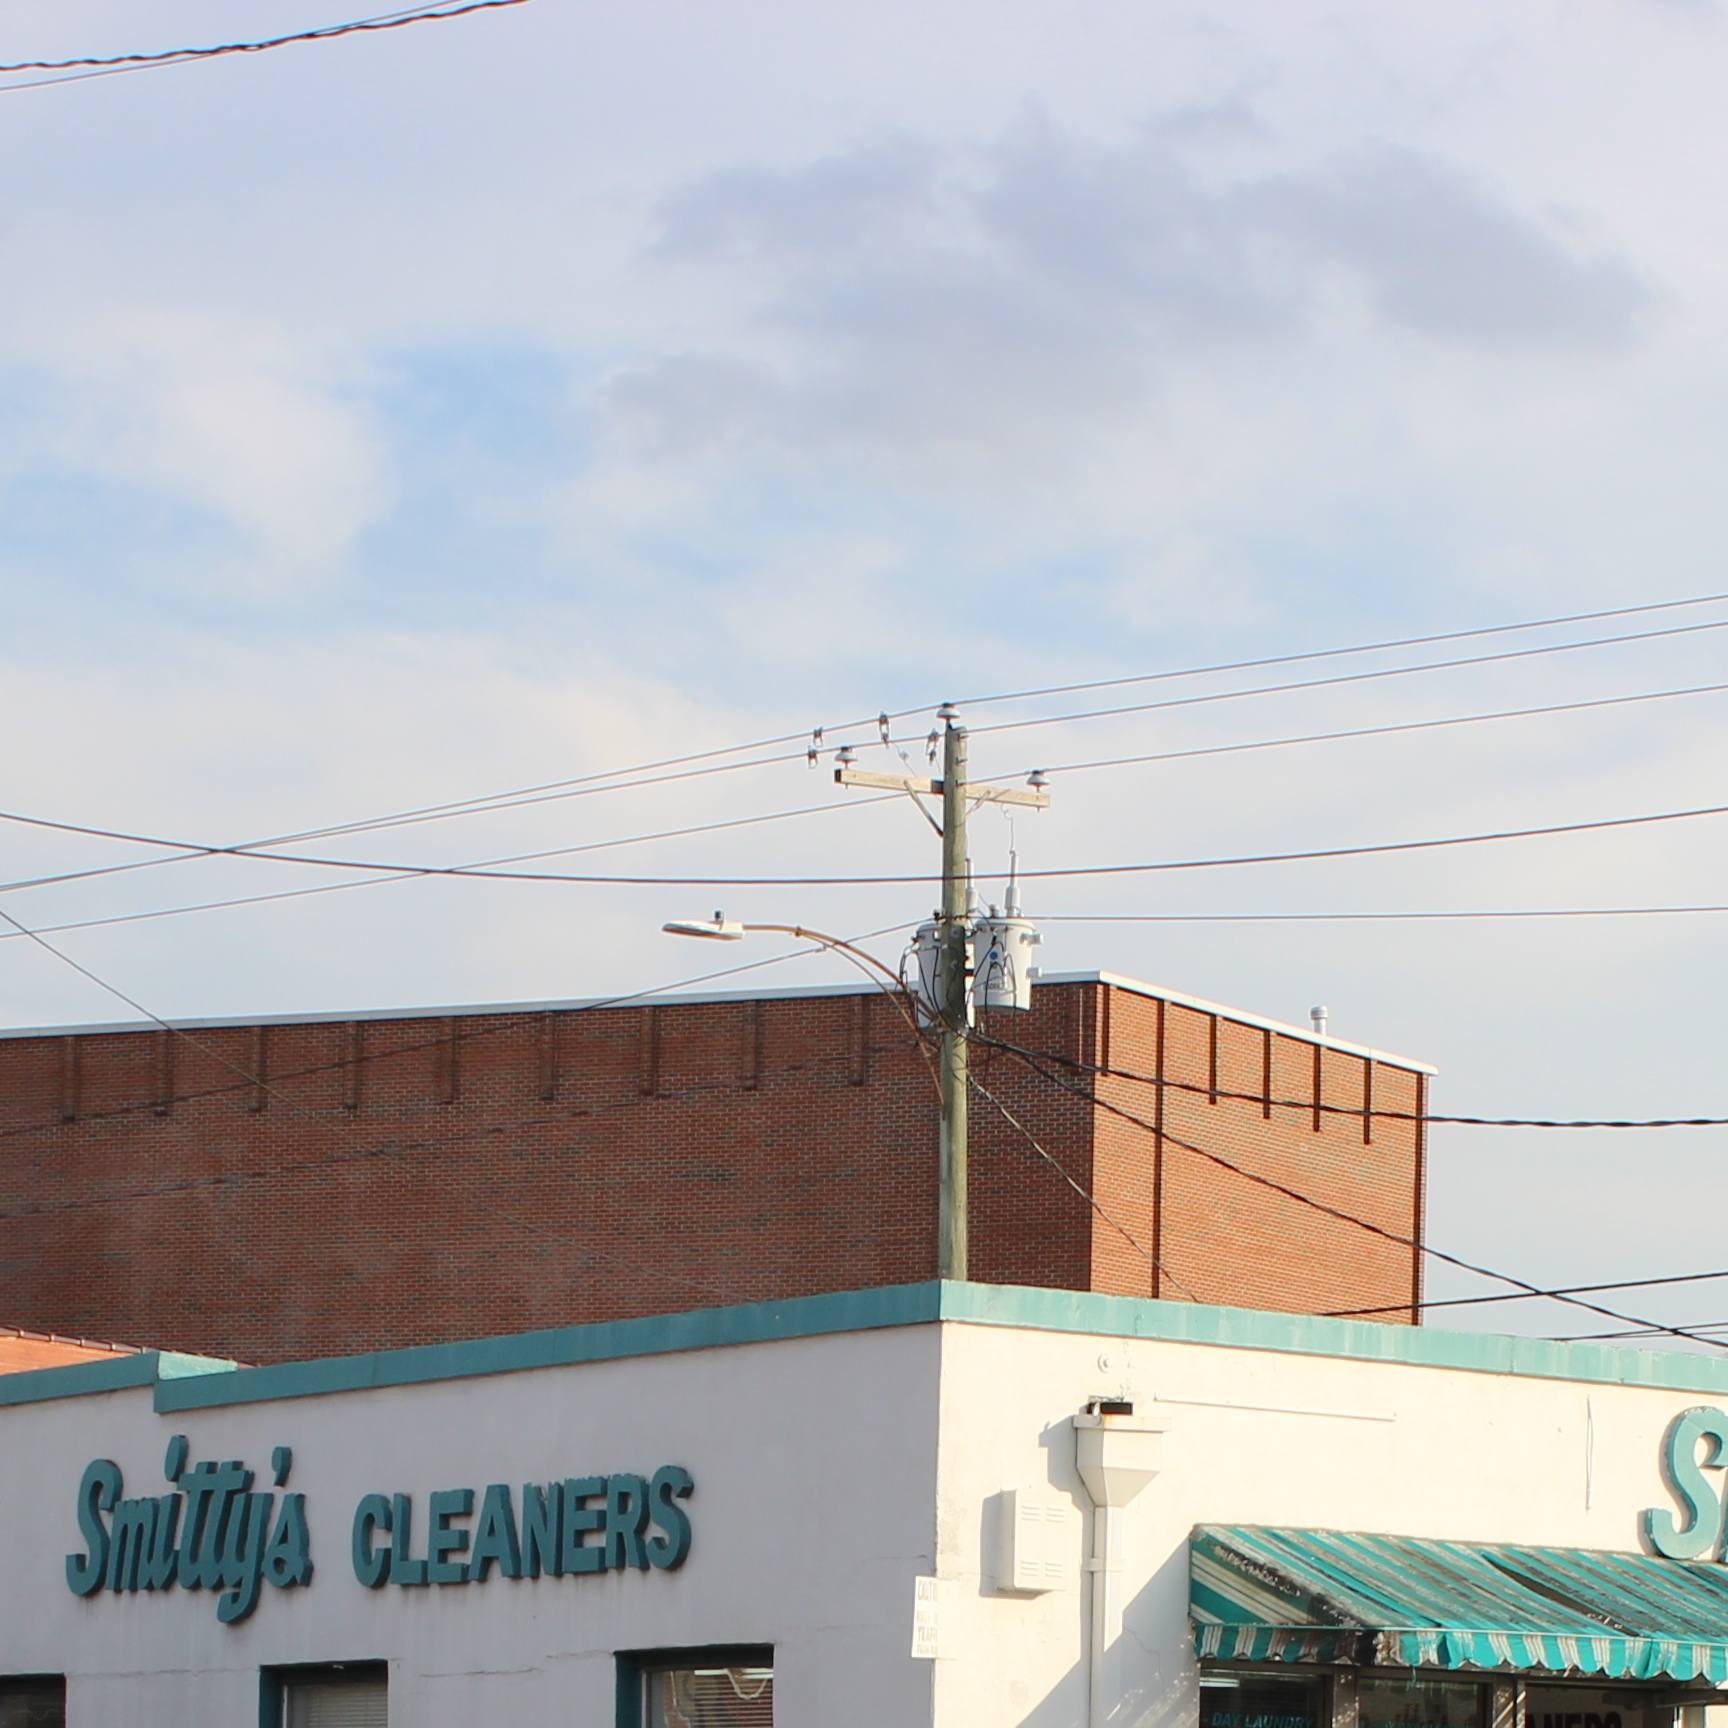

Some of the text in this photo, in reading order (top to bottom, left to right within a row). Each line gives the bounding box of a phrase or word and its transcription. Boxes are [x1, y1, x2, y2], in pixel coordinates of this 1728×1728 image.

[65, 1434, 694, 1625] Smitty's CLEANERS
[1212, 1712, 1241, 1727] DAY
